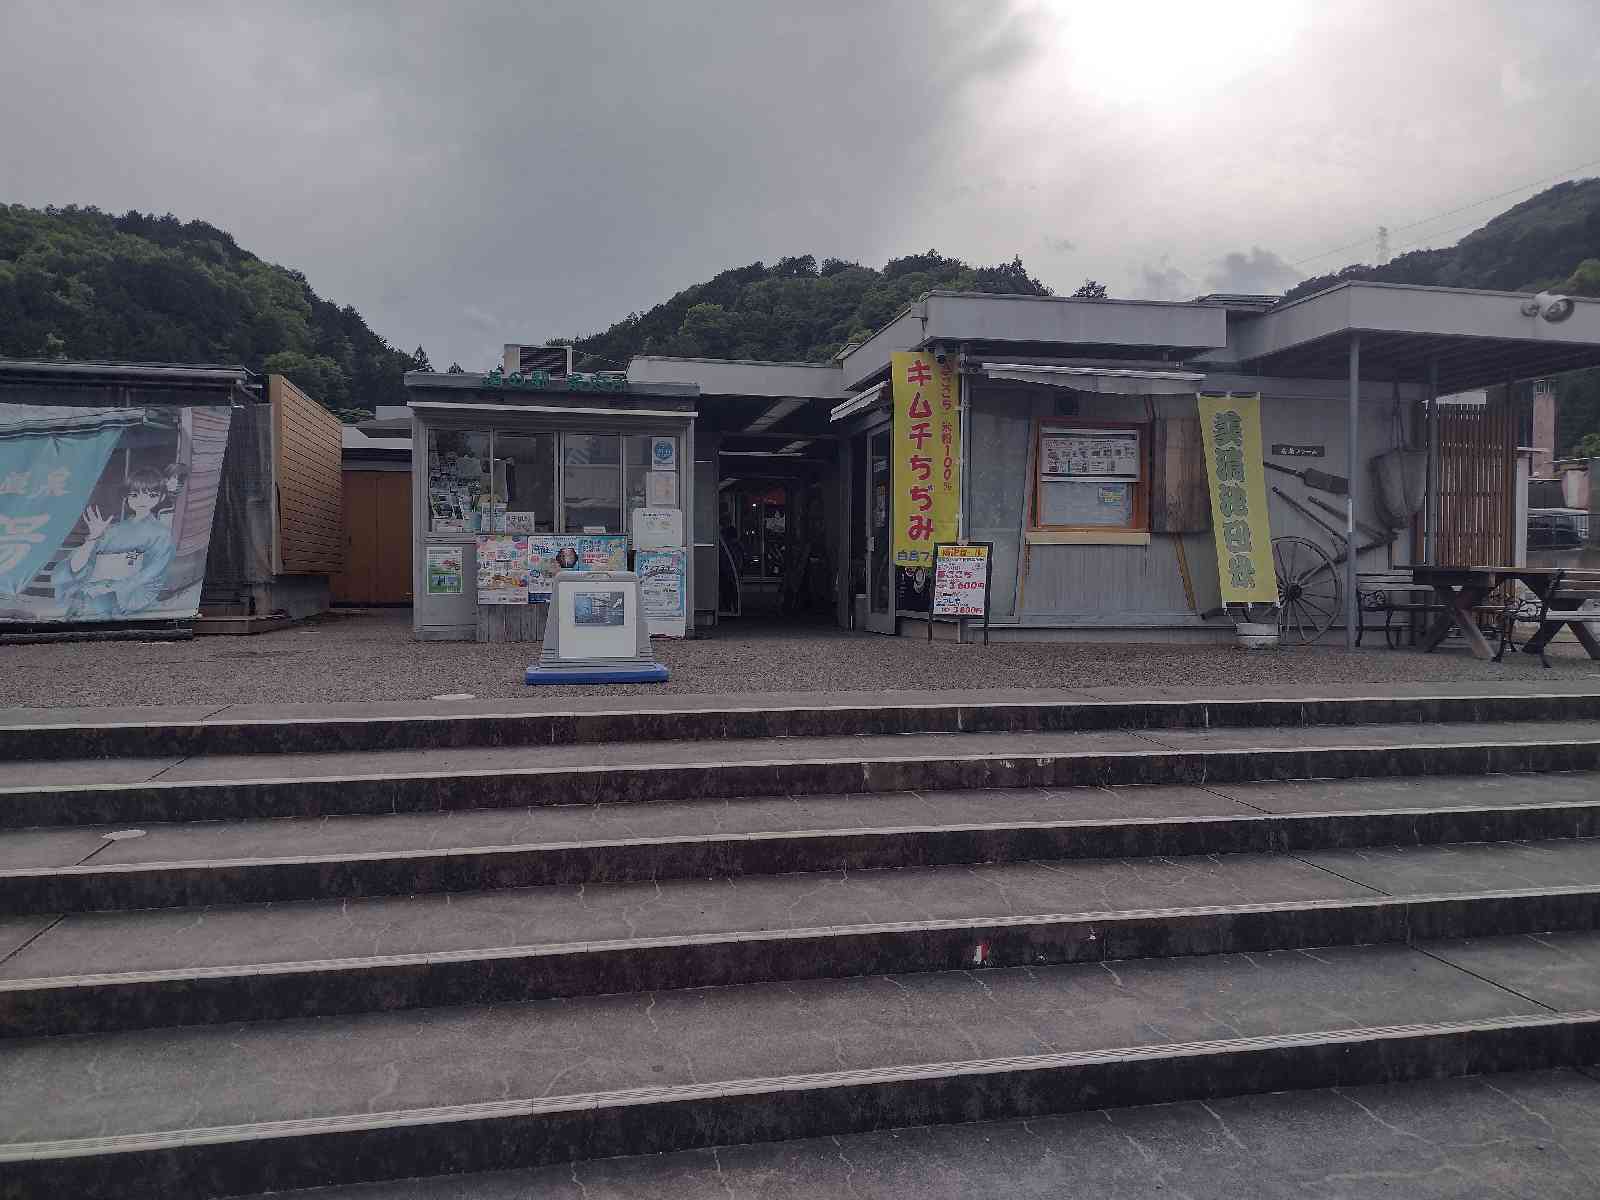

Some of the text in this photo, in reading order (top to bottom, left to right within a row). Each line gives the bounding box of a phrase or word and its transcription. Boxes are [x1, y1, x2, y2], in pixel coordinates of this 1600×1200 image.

[906, 359, 934, 542] キムチちぢみ
